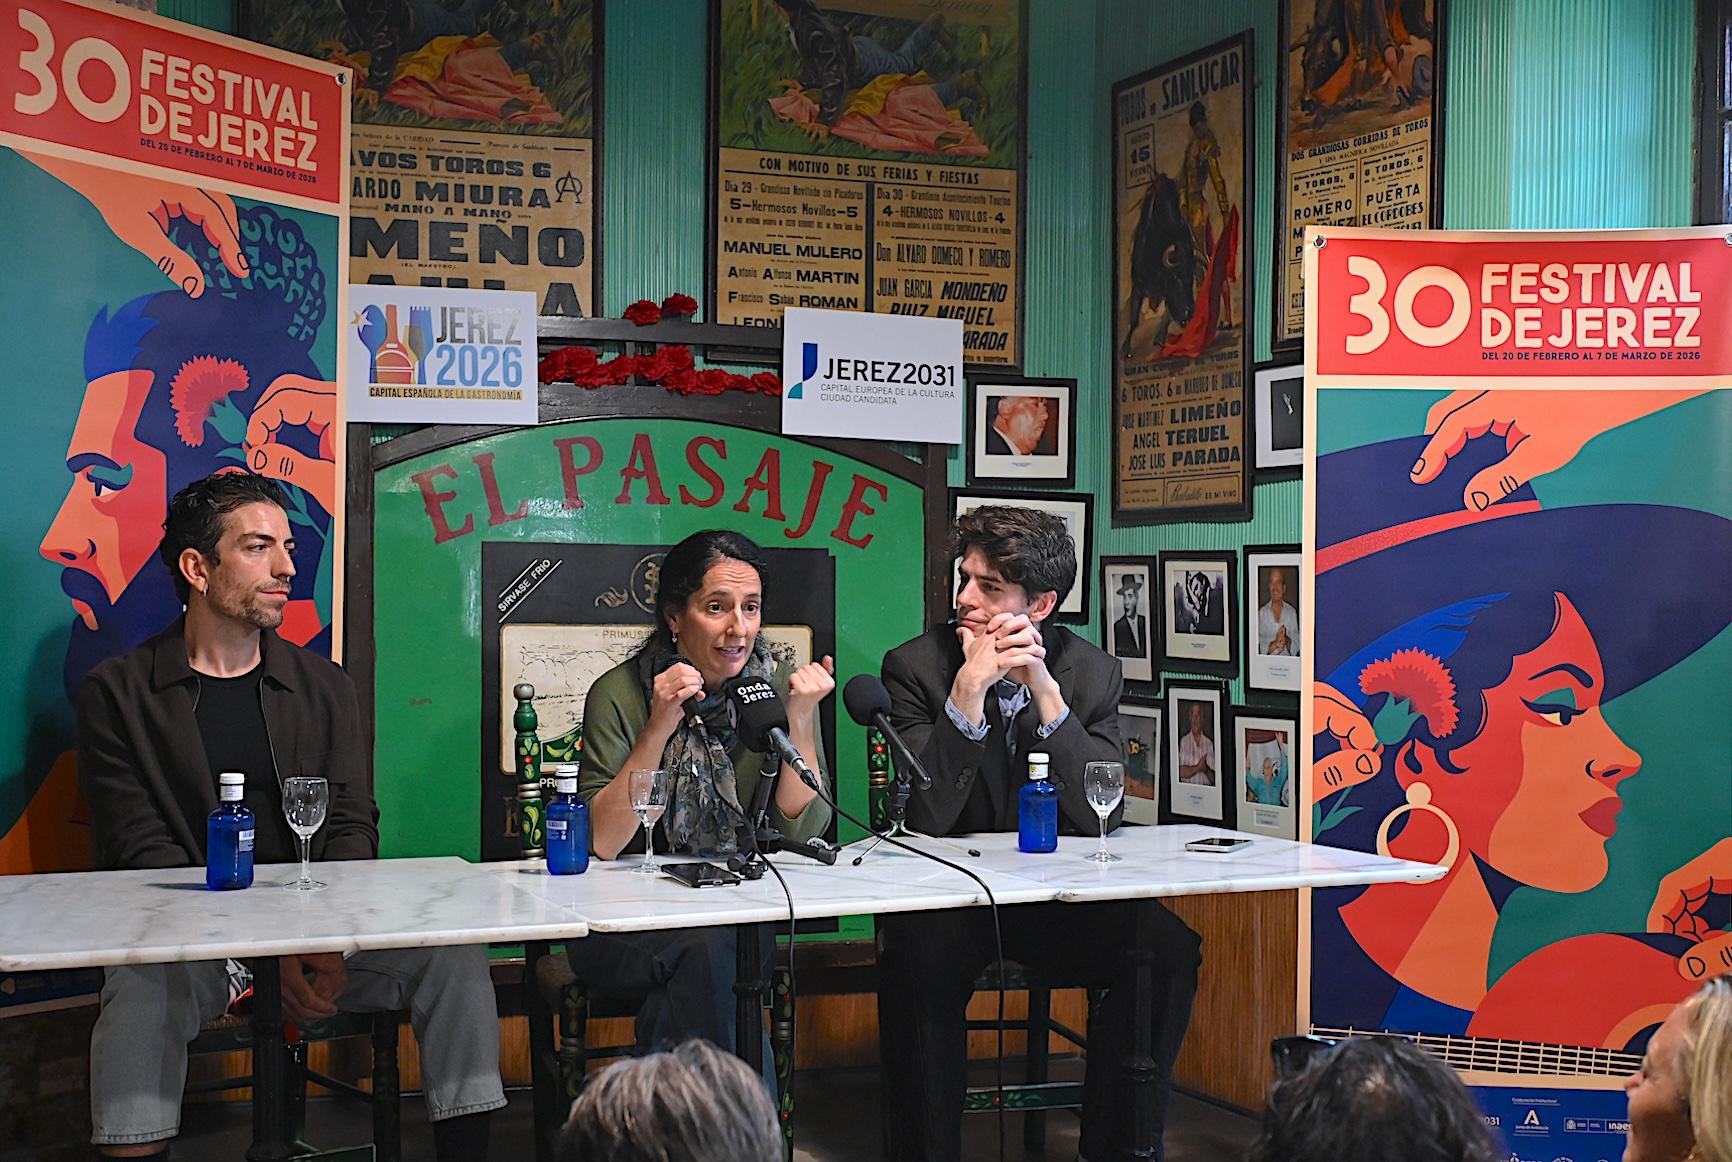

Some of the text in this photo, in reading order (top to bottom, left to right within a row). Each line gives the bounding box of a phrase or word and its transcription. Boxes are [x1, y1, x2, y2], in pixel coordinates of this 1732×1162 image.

[14, 8, 132, 123] 30
[140, 48, 318, 130] FESTIVAL
[1162, 52, 1239, 110] SANLUCAR
[140, 94, 318, 172] DE JEREZ
[1292, 118, 1429, 162] DOS GRANDIOSAS CORRIDAS DE TOROS
[140, 138, 156, 148] DEL
[158, 142, 168, 152] 20
[171, 144, 182, 154] DE
[184, 147, 223, 163] FEBRERO
[226, 157, 234, 166] AL
[244, 162, 254, 170] DE
[256, 164, 284, 176] MARZO
[286, 170, 297, 179] DE
[298, 172, 317, 184] 2026
[426, 155, 524, 176] TOROS
[532, 162, 552, 178] 6
[760, 158, 980, 185] CON MOTIVO DE SUS FERIAS Y FIESTAS
[352, 176, 551, 208] ARDO MIURA
[742, 182, 752, 194] 29
[893, 188, 903, 200] 30
[1366, 183, 1420, 206] PUERTA
[385, 204, 434, 214] MANO
[444, 207, 454, 216] A
[464, 208, 512, 218] MANO
[1294, 199, 1352, 220] ROMERO
[1362, 214, 1374, 226] EL
[350, 216, 585, 267] MEÑO
[724, 240, 863, 260] MANUEL MULERO
[876, 242, 1011, 268] Don ALVARO DOMECQ Y ROMERO
[796, 269, 860, 285] MARTIN
[1481, 262, 1702, 305] FESTIVAL
[800, 294, 858, 310] ROMAN
[876, 277, 1008, 303] JUAN GARCIA MONDEÑO
[937, 304, 996, 326] MIGUEL
[1345, 256, 1472, 355] 30
[436, 306, 522, 345] JEREZ
[1481, 306, 1702, 349] DE JEREZ
[436, 344, 523, 388] 2026
[1482, 352, 1701, 360] DEL 20 DE FEBRERO AL 7 DE MARZO DE 2026
[824, 358, 954, 387] JEREZ2031
[370, 387, 402, 398] CAPITAL
[404, 387, 442, 398] ESPAÑOLA
[444, 389, 454, 398] DE
[455, 389, 464, 399] LA
[820, 384, 954, 399] CAPITAL EUROPEA DE LA CULTURA
[820, 394, 897, 405] CIUDAD CANDIDATA
[1122, 388, 1128, 402] 6
[1167, 382, 1173, 397] 6
[1170, 398, 1241, 424] LIMEÑO
[1133, 424, 1230, 450] ANGEL TERUEL
[1128, 454, 1146, 471] JOSE
[1150, 452, 1166, 470] LUIS
[1172, 446, 1240, 467] PARADA
[411, 433, 889, 549] EL PASAJE
[1222, 490, 1237, 498] VINO
[498, 559, 551, 612] SIRVASE FRIO
[737, 682, 771, 696] Onda
[742, 690, 776, 704] Jerez
[1608, 1122, 1632, 1131] inae
